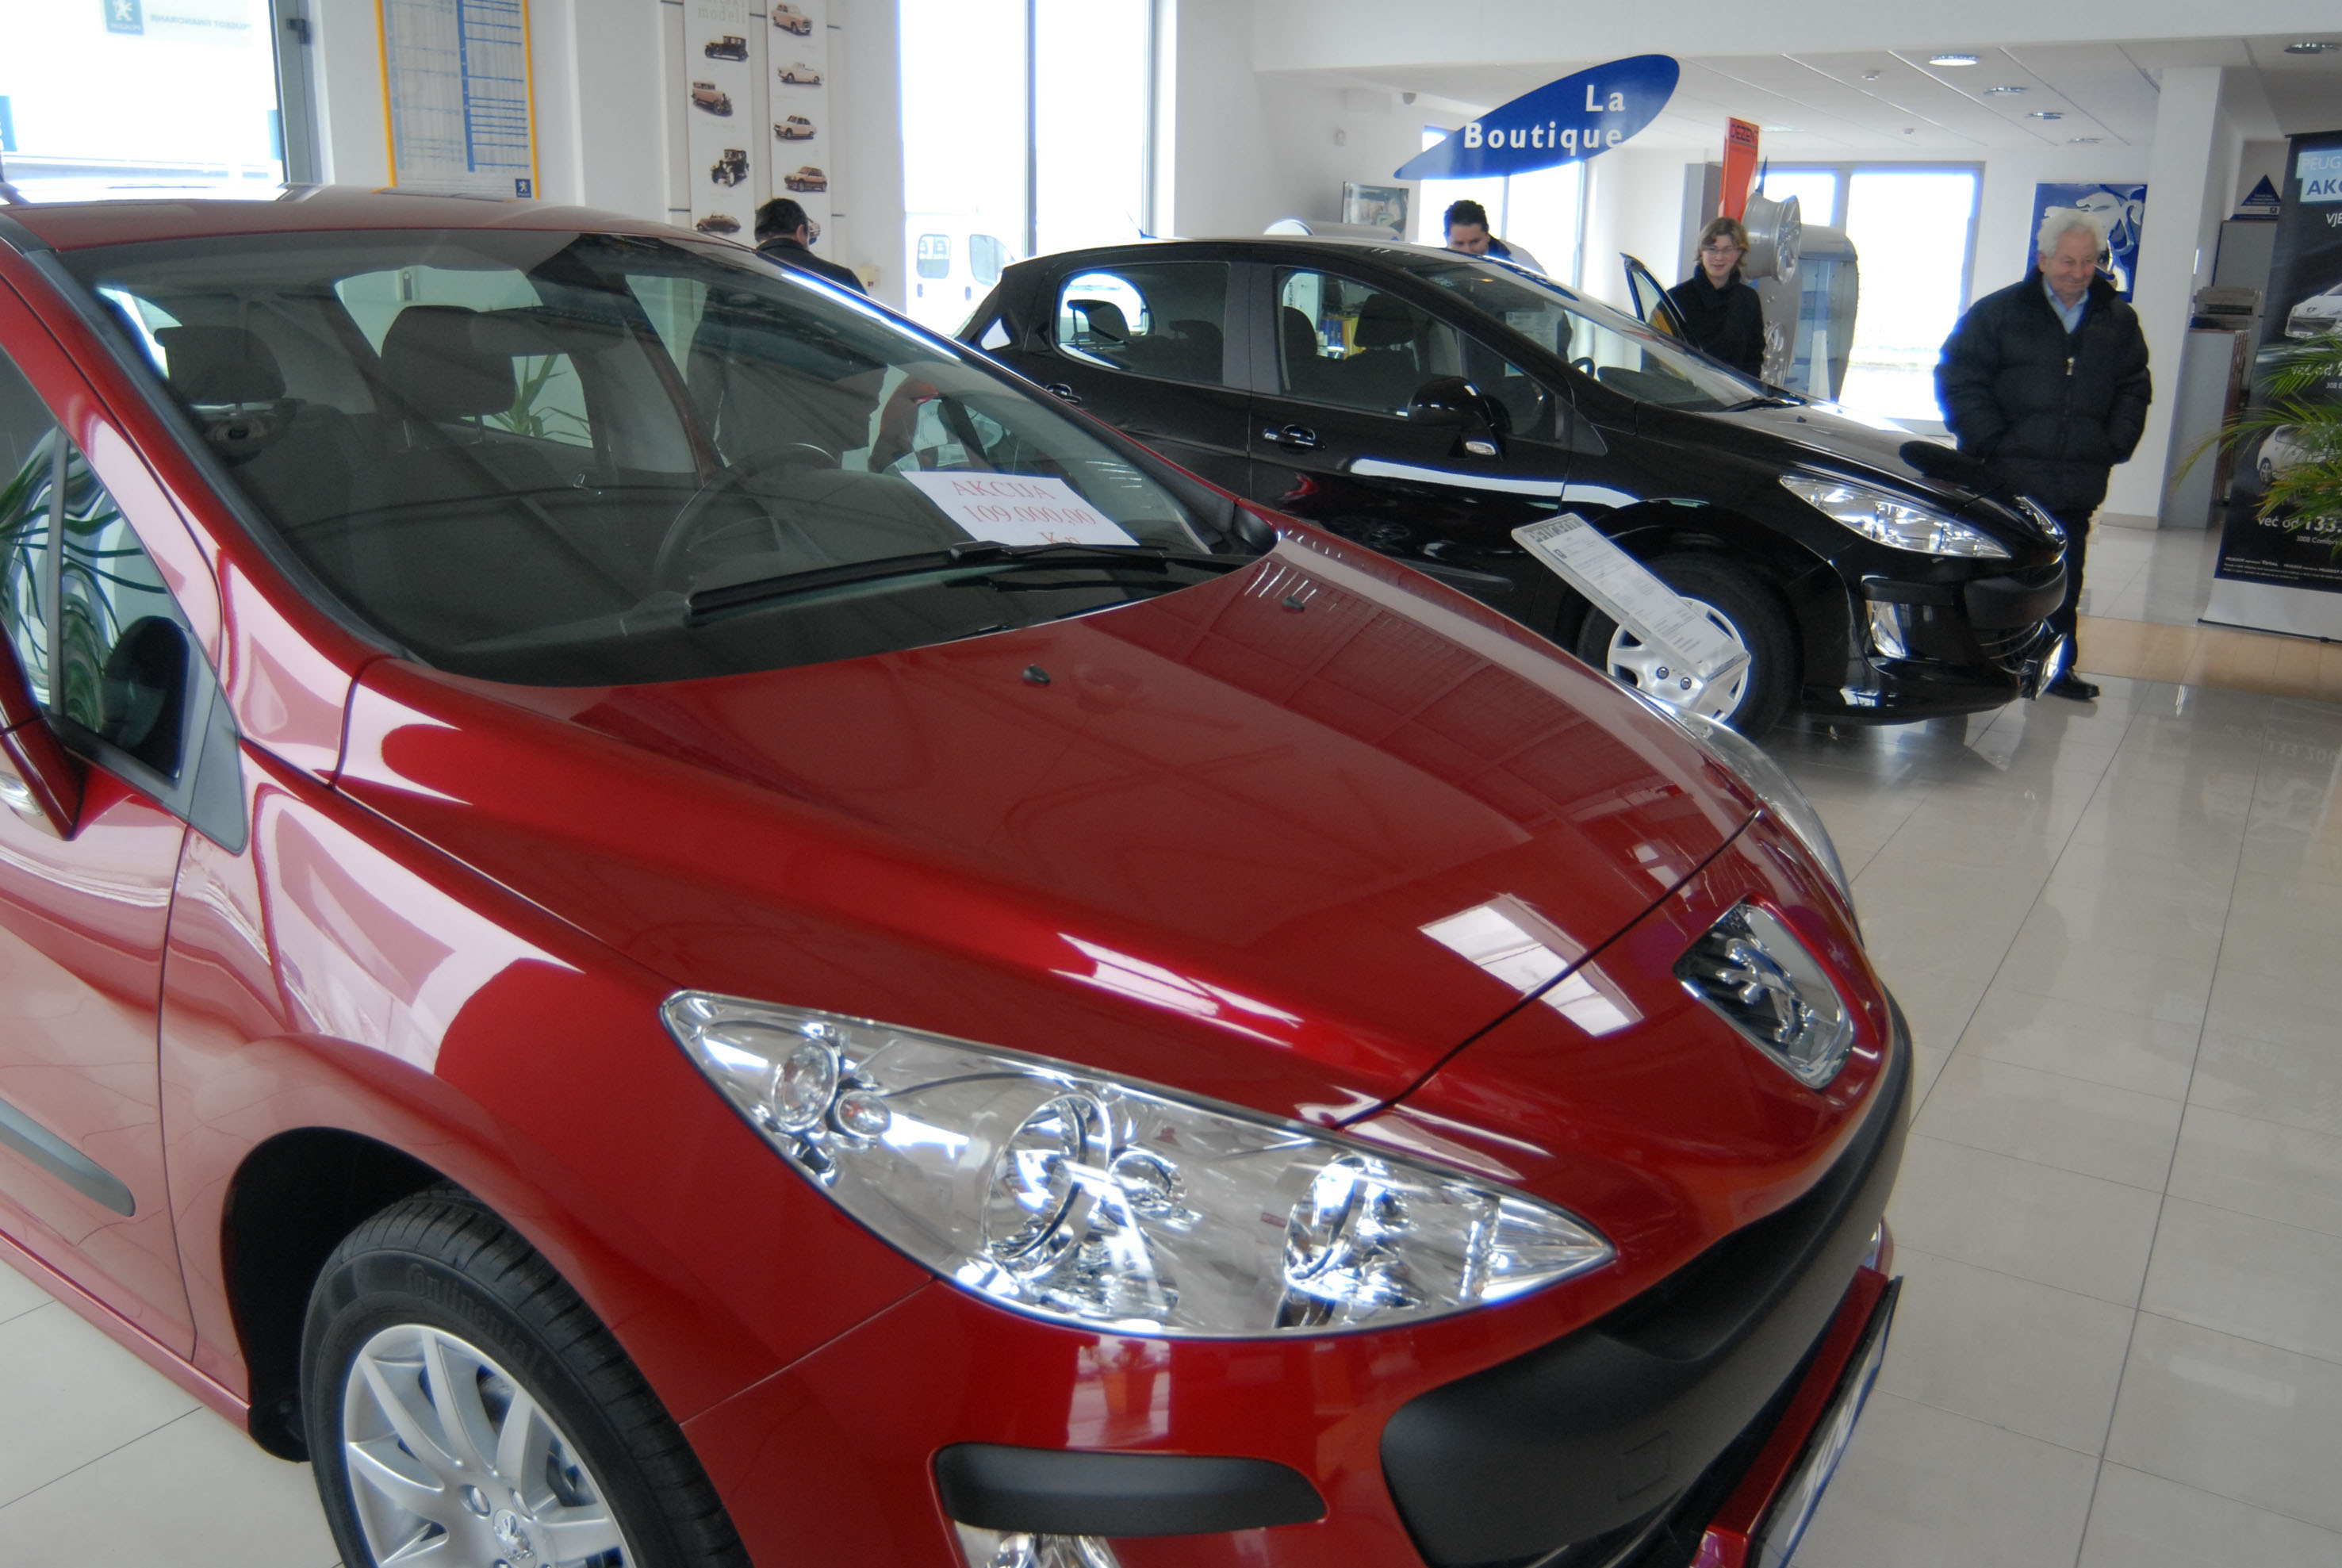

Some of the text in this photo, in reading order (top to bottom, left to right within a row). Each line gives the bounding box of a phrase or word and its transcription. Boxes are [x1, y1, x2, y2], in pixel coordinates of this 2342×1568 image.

[1585, 84, 1626, 113] La
[1463, 121, 1623, 156] Boutique
[952, 481, 1056, 500] AKCIJA
[962, 505, 1097, 526] 109.000,00
